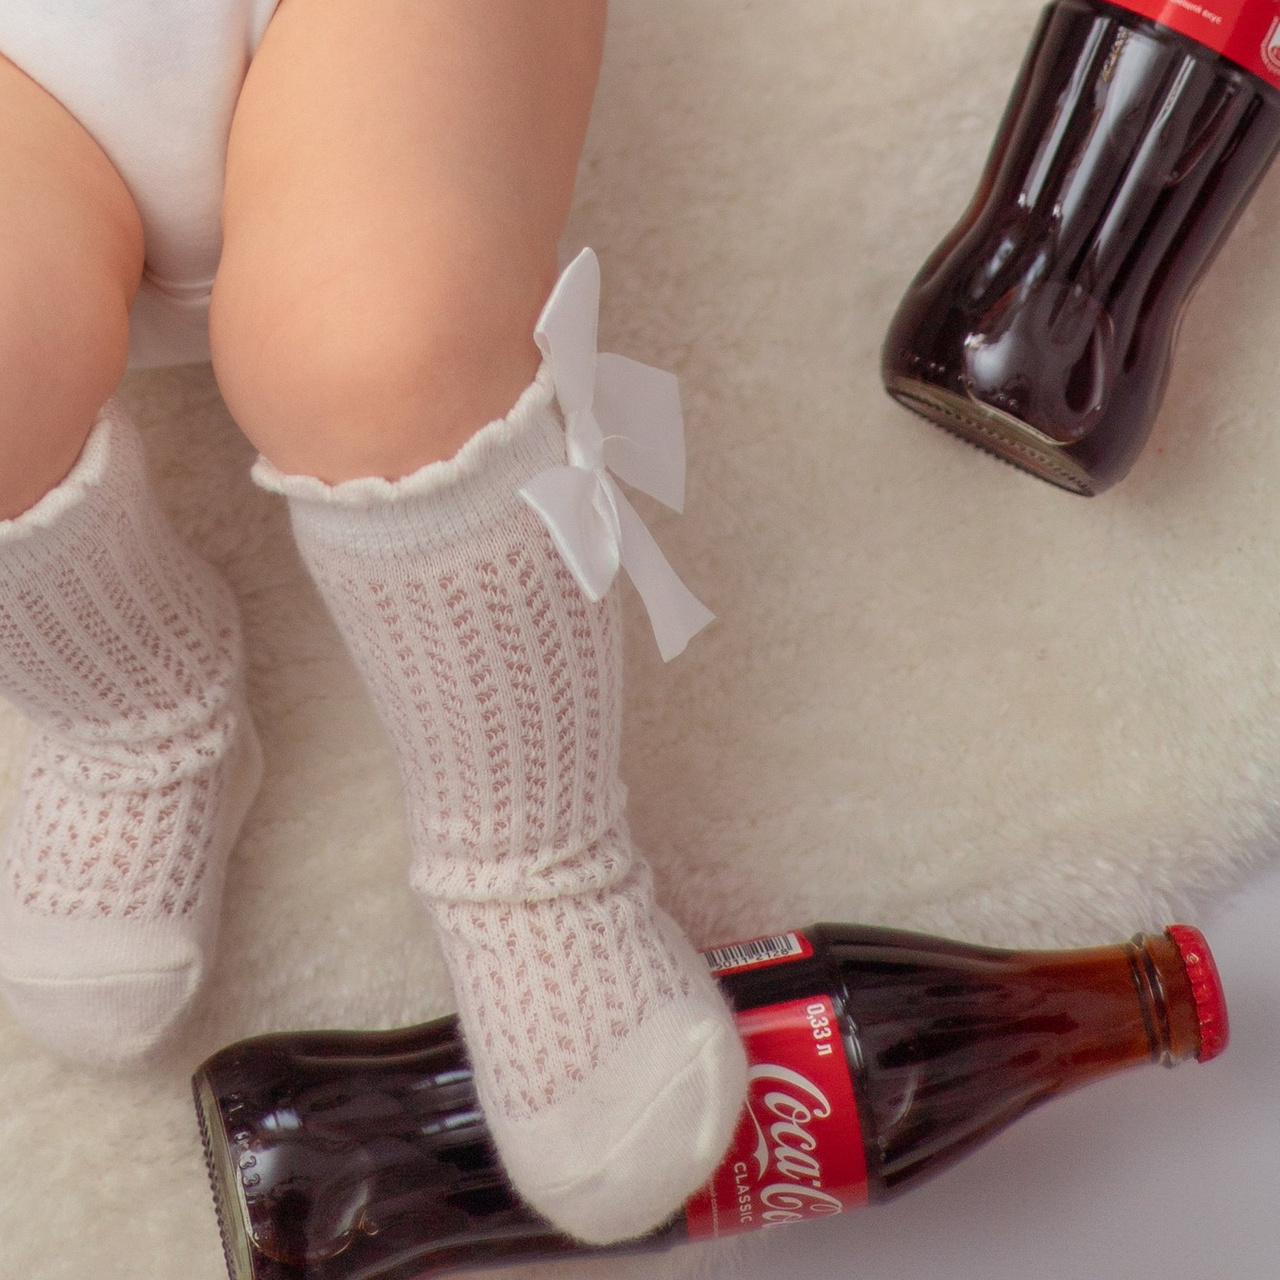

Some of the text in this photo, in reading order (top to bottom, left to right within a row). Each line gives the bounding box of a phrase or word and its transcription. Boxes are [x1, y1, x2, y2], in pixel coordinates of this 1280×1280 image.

[754, 948, 791, 962] 2128
[806, 1002, 833, 1058] 0,33 л
[733, 1161, 753, 1225] CLASSIC
